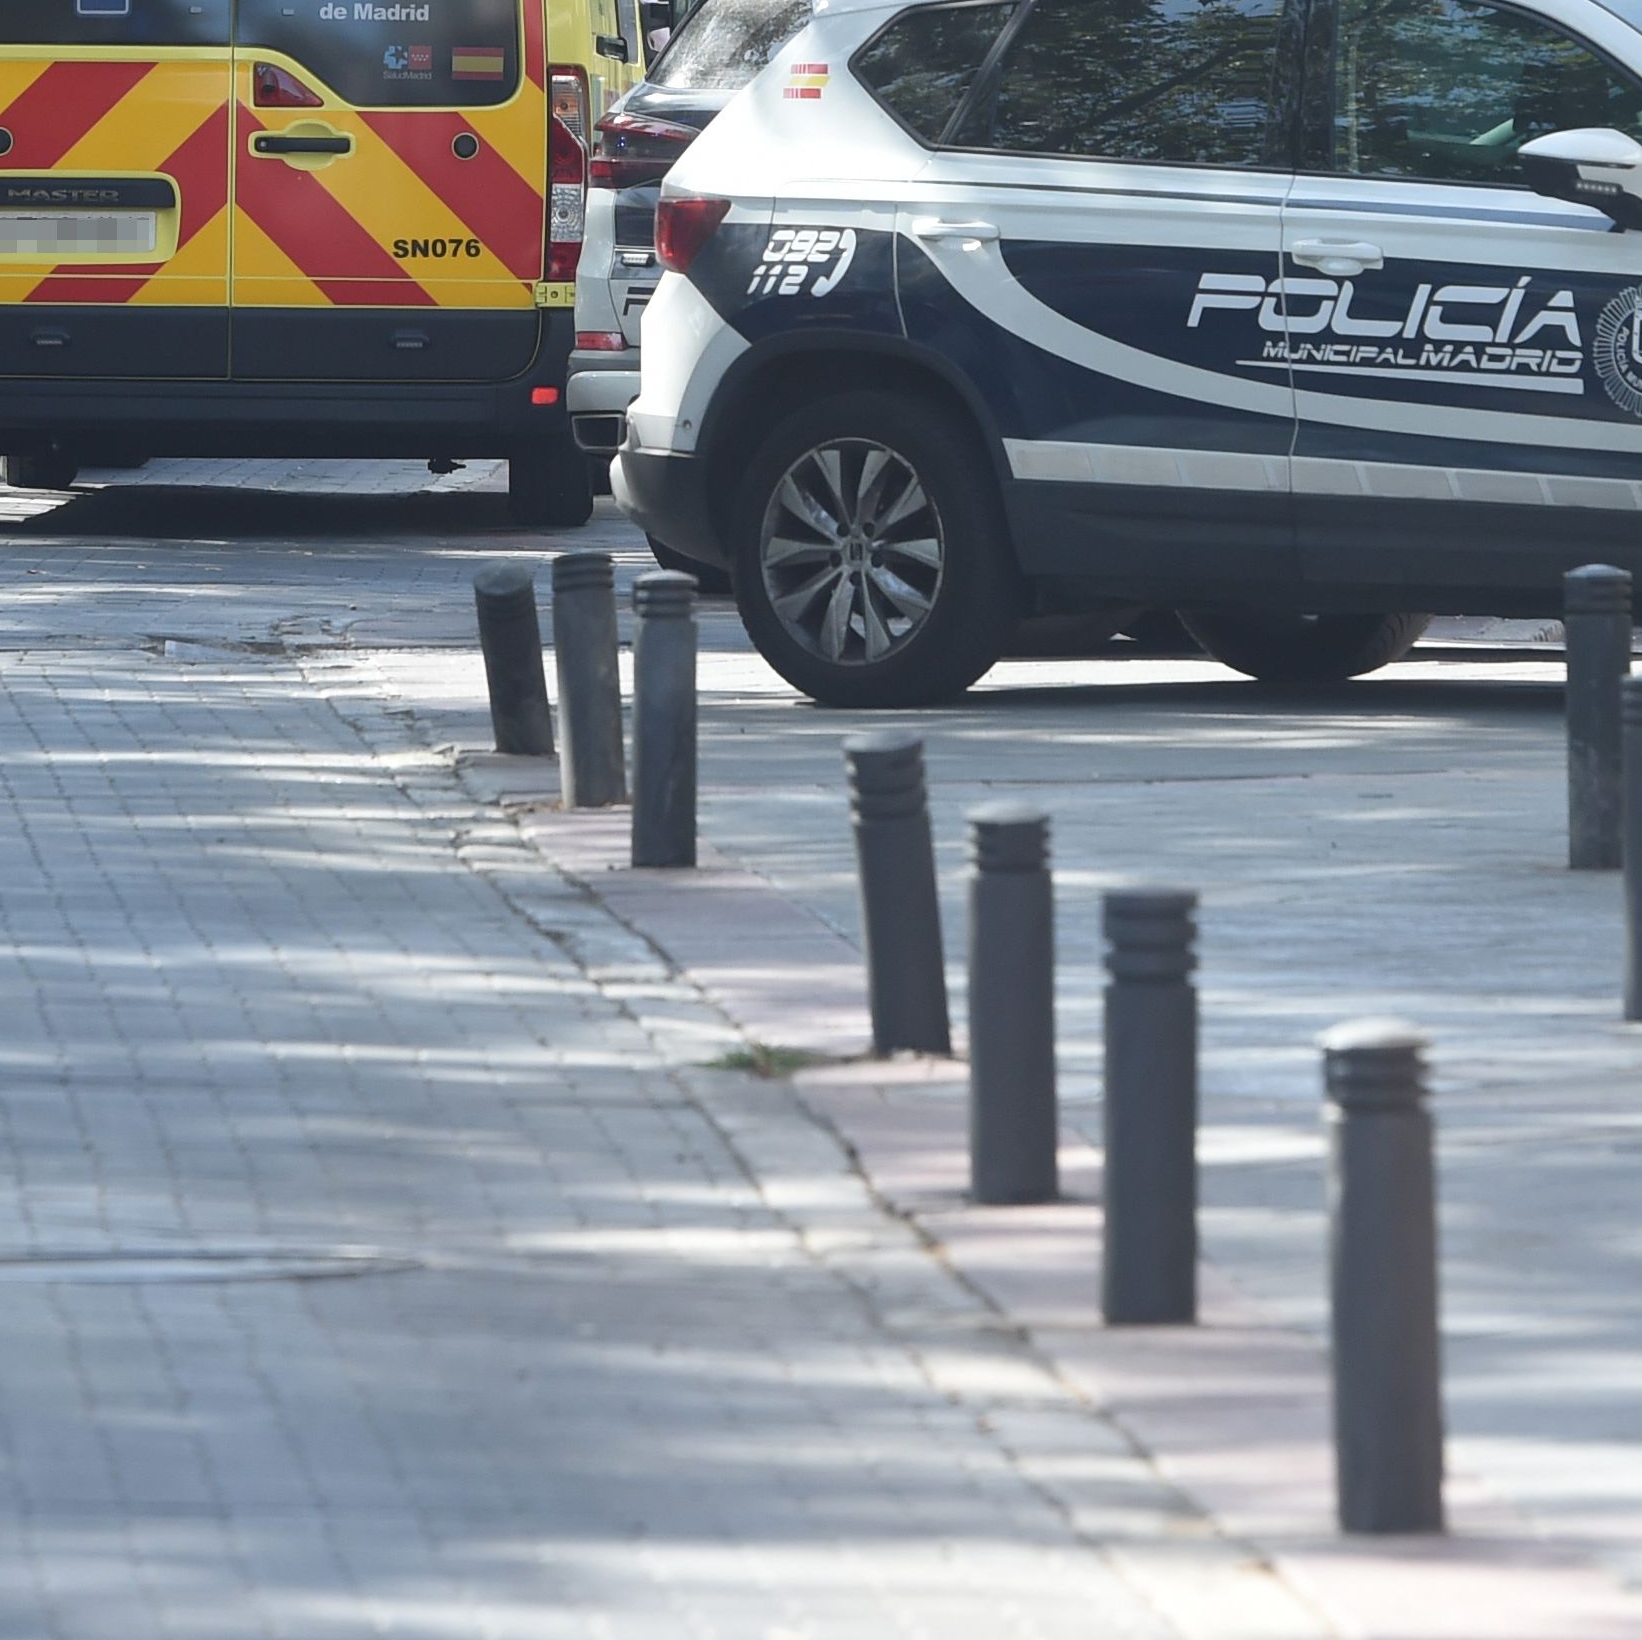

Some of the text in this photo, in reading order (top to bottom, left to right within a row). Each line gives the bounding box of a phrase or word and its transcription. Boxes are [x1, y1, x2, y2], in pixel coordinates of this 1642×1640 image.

[319, 3, 430, 21] de Madrid
[383, 70, 432, 80] SaludMadrid
[7, 188, 120, 202] MASTER
[392, 238, 482, 259] SN076
[762, 229, 841, 262] 092
[747, 264, 809, 296] 112
[1186, 272, 1583, 348] POLICÍA
